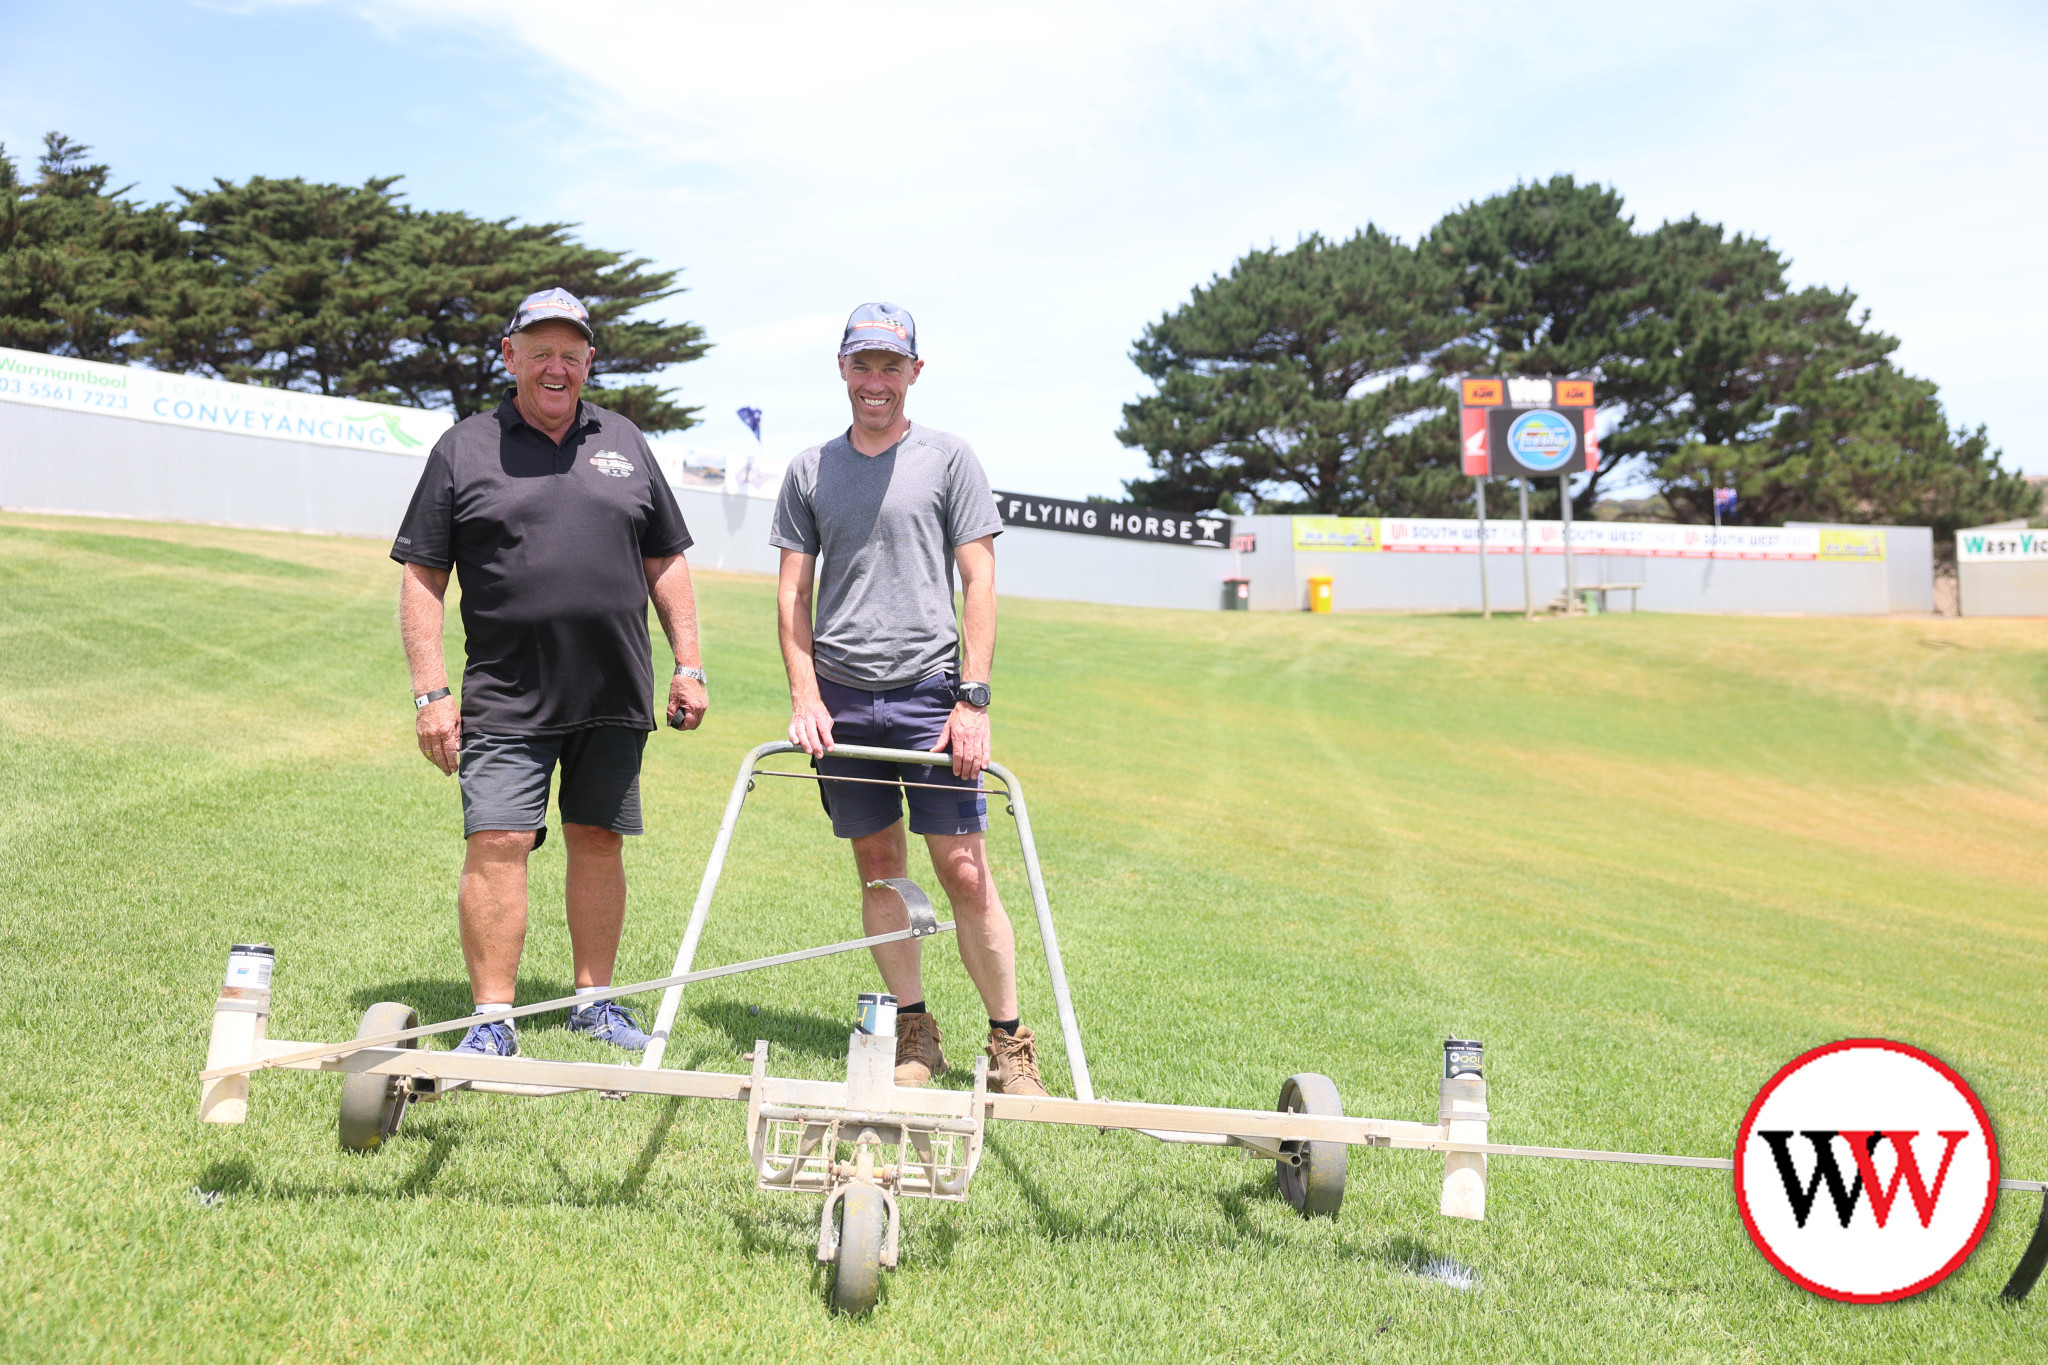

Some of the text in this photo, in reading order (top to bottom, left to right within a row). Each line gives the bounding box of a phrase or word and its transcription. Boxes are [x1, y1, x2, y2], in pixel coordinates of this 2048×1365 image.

[0, 357, 127, 390] Warrnambool
[0, 377, 129, 410] 03 5561 7223
[155, 380, 241, 402] SOUTH
[152, 397, 387, 445] CONVEYANCING
[1008, 499, 1193, 540] FLYING HORSE
[1411, 525, 1458, 539] SOUTH
[1462, 527, 1498, 540] WEST
